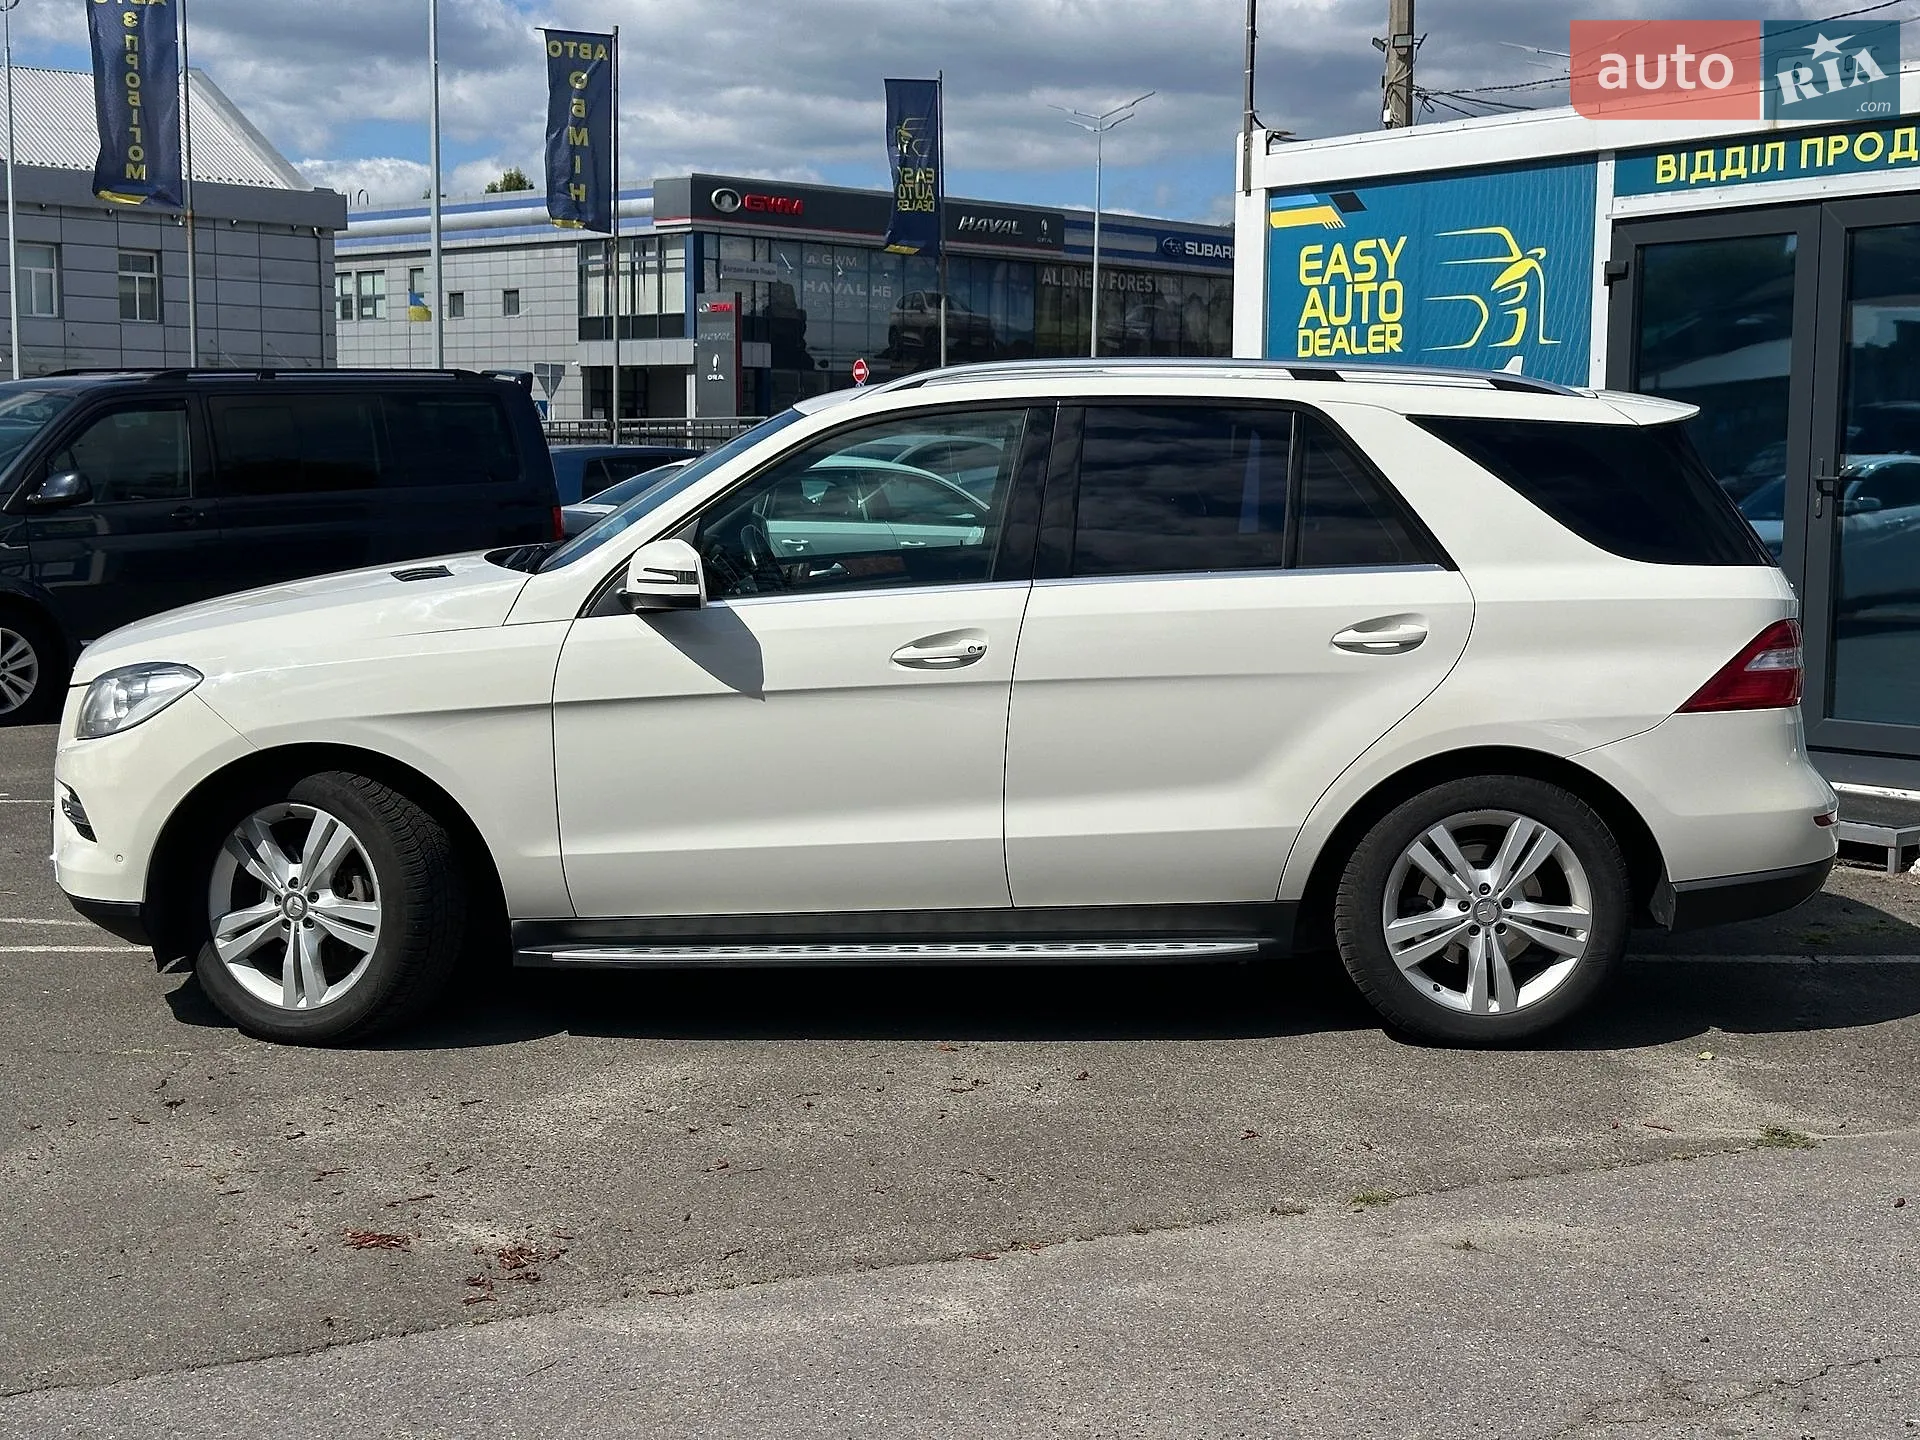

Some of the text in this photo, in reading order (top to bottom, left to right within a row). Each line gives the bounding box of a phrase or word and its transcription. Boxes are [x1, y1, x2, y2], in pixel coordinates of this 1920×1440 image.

[1656, 126, 1919, 185] ВІДДІЛ ПРОД
[744, 192, 804, 216] GWM
[957, 215, 1023, 235] HAVAL
[821, 253, 857, 267] GWM
[1185, 240, 1234, 260] SUBAR
[1299, 235, 1408, 287] EASY
[1041, 266, 1070, 286] ALL
[803, 280, 892, 298] HAVAL H6
[1298, 280, 1404, 329] AUTO
[1297, 323, 1404, 358] DEALER
